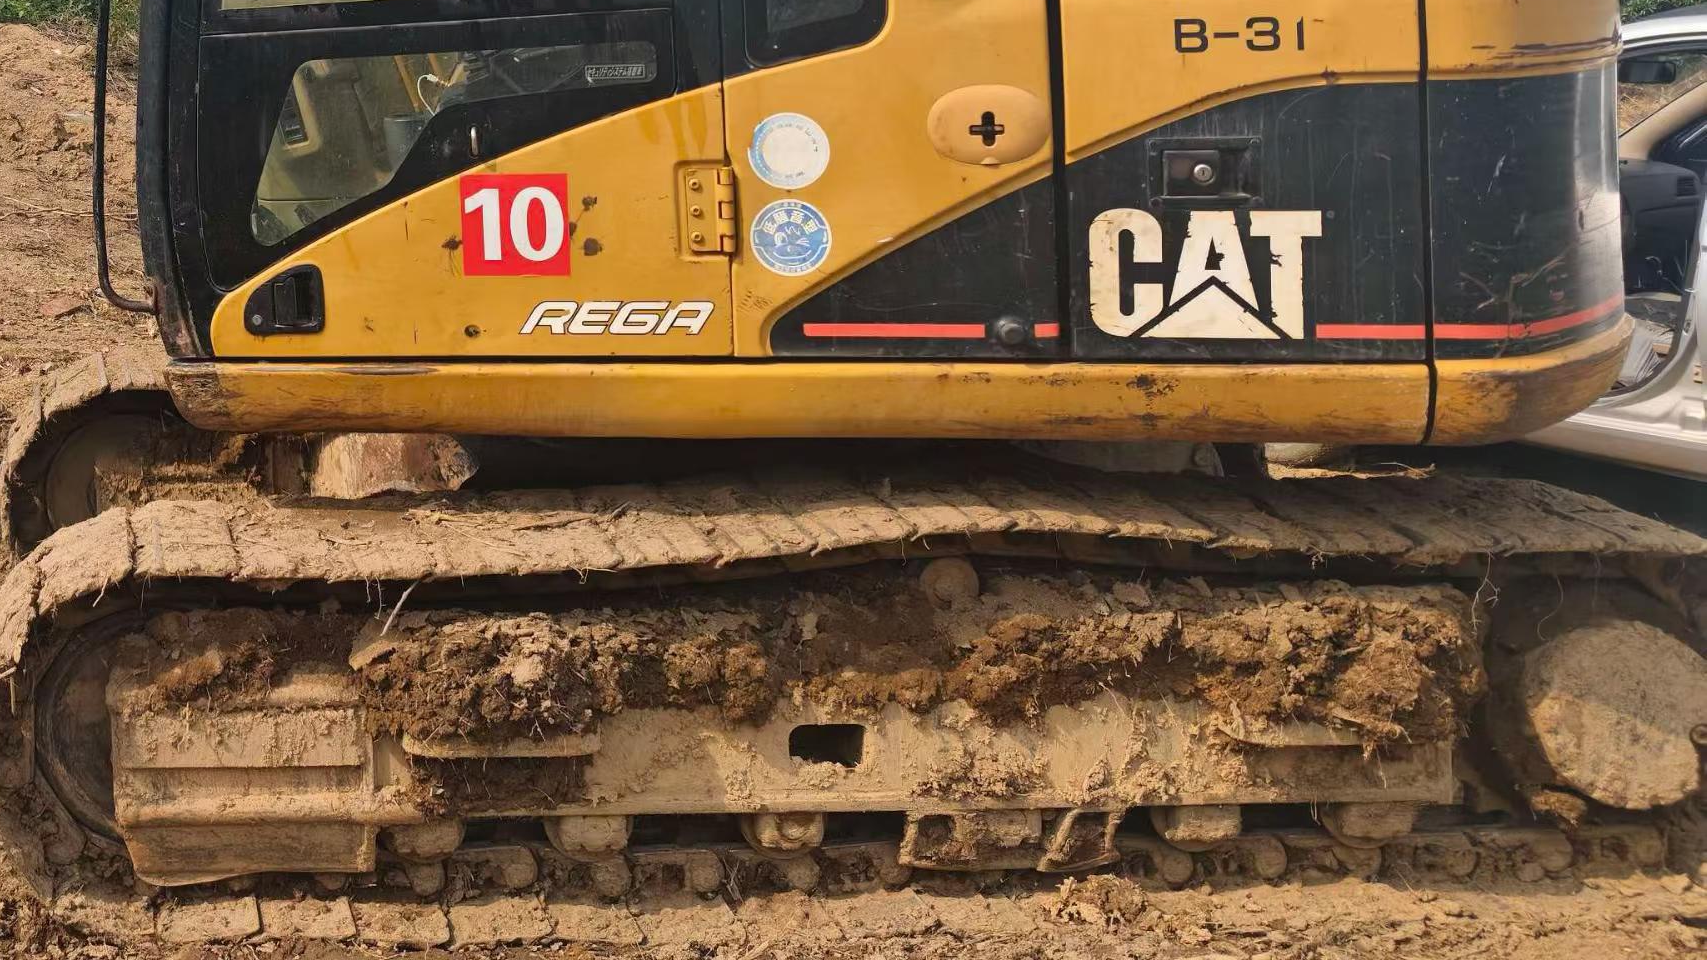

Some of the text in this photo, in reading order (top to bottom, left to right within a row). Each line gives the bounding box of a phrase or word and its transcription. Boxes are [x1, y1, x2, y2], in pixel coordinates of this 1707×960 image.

[1174, 16, 1305, 53] B-31
[463, 186, 565, 262] 10
[1089, 208, 1322, 340] CAT
[518, 300, 715, 336] REGA
